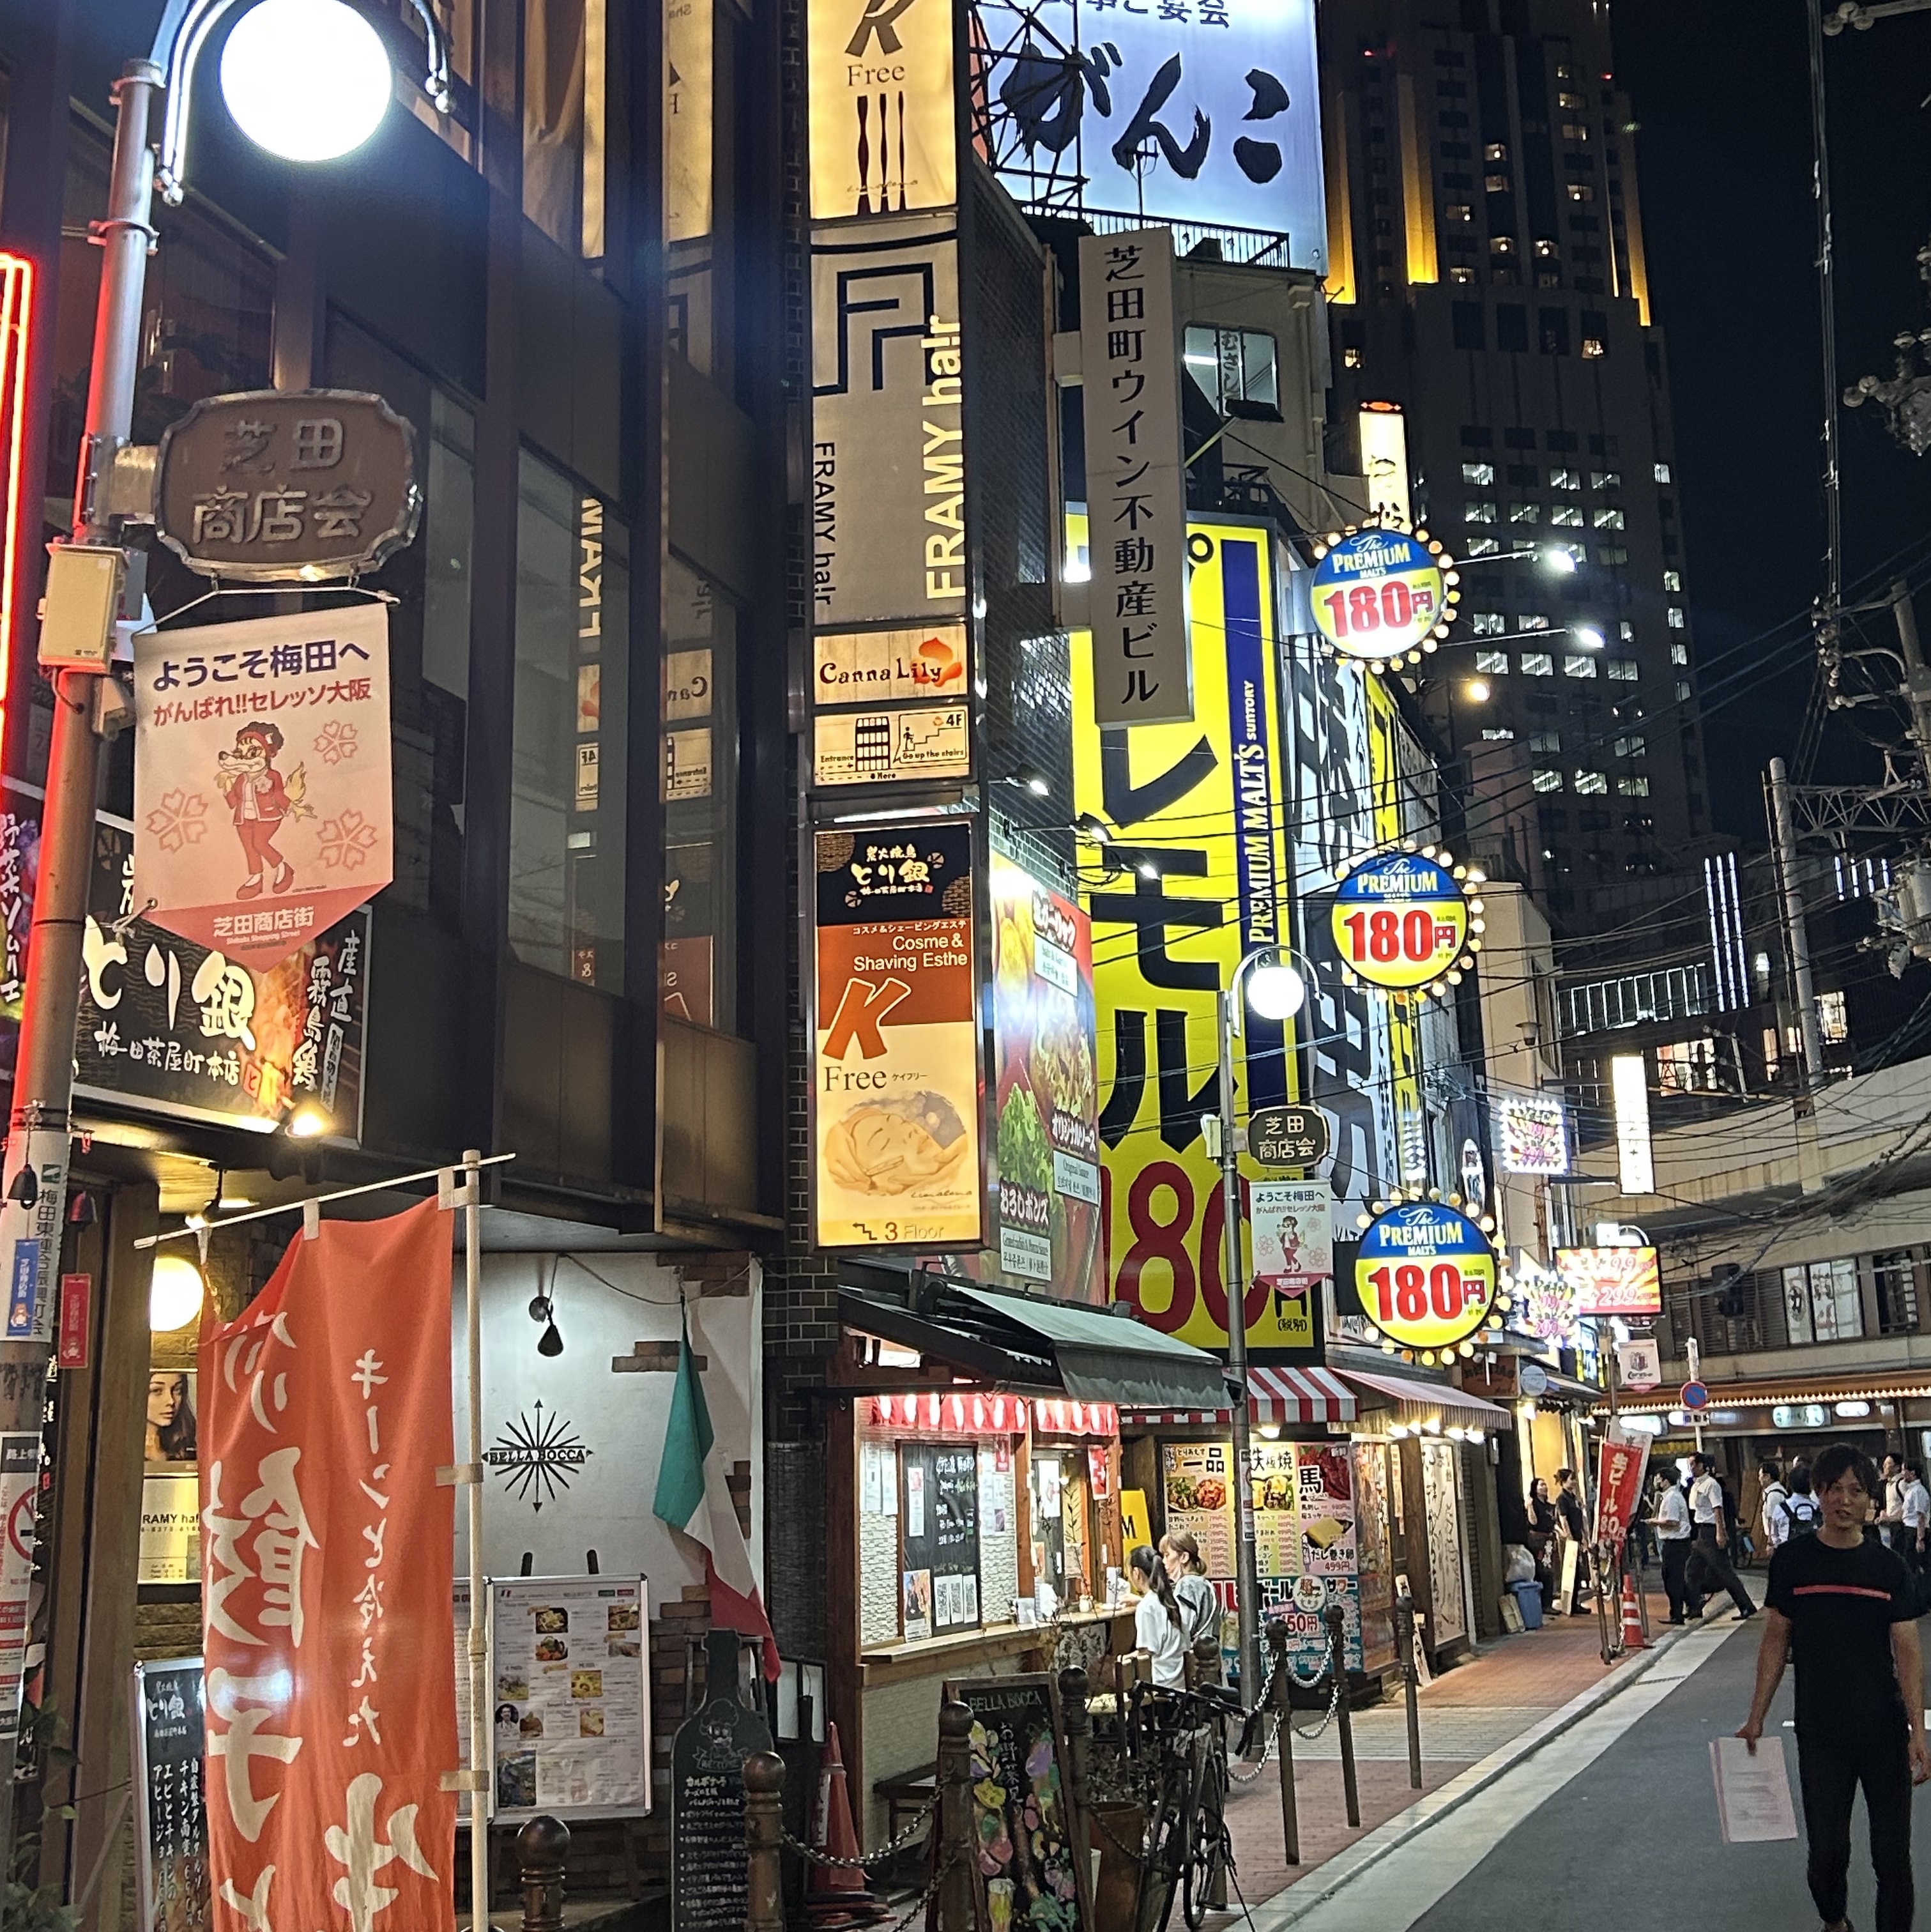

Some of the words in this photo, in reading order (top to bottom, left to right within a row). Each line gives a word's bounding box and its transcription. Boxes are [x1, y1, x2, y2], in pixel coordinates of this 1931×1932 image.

[847, 63, 905, 86] Free
[1000, 42, 1290, 184] がんこ
[920, 314, 962, 406] hair
[222, 418, 344, 473] 芝田
[1104, 245, 1159, 704] 芝田町ウイン不動産ビル
[814, 442, 836, 542] FRAMY
[193, 484, 373, 544] 商店会
[922, 420, 966, 599] FRAMY
[1350, 535, 1389, 552] The
[1332, 542, 1411, 574] PREMIUM
[814, 552, 836, 604] hair
[153, 640, 370, 691] ようこそ梅田へ
[820, 662, 890, 684] Canna
[896, 657, 942, 682] Lily
[153, 677, 372, 727] がんばれ!!セレッソ大阪
[946, 714, 963, 726] 4F
[915, 752, 925, 760] up
[1234, 744, 1269, 832] MALT'S
[851, 859, 929, 885] とり銀
[1377, 858, 1416, 875] The
[1244, 835, 1275, 944] PREMIUM
[1357, 871, 1438, 894] PREMIUM
[213, 906, 314, 937] 芝田商店街
[892, 936, 948, 951] Cosme
[951, 933, 964, 948] &
[853, 954, 917, 972] Shaving
[923, 951, 968, 967] Esthe
[82, 914, 256, 1051] とり銀
[822, 977, 912, 1061] K
[94, 1021, 240, 1085] 梅田茶屋町本店
[823, 1066, 887, 1092] Free
[892, 1072, 928, 1082] ケイフリー
[1265, 1116, 1304, 1135] 芝田
[1258, 1138, 1316, 1160] 商店会
[1256, 1190, 1325, 1202] ようこそ梅田へ
[1398, 1208, 1440, 1226] The
[885, 1222, 898, 1241] 3
[903, 1223, 945, 1240] Floor
[1378, 1222, 1464, 1247] PREMIUM
[1099, 1162, 1270, 1334] 80
[1368, 1263, 1486, 1321] 180円
[489, 1450, 533, 1464] BELLA
[537, 1448, 584, 1462] BOCCA
[1182, 1447, 1225, 1473] 一品
[1299, 1466, 1323, 1494] 馬
[1603, 1452, 1629, 1514] 生ビール
[1281, 1614, 1318, 1633] 50円
